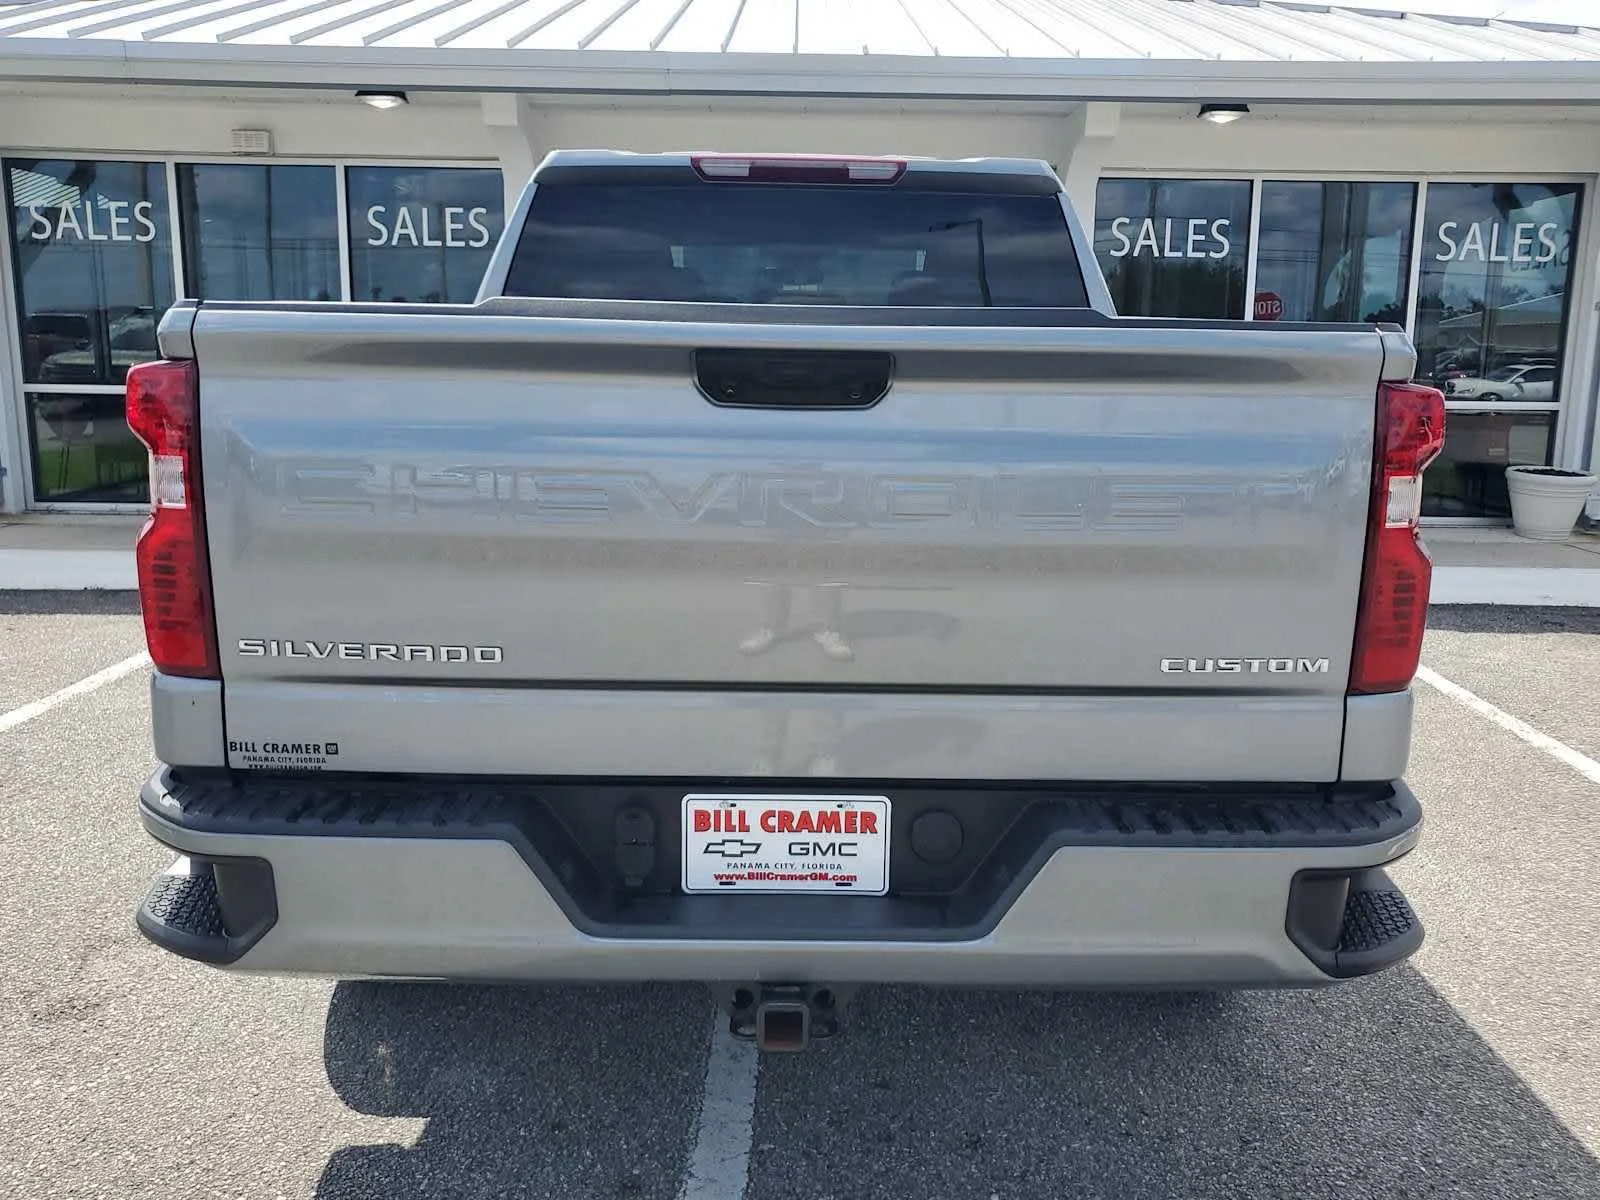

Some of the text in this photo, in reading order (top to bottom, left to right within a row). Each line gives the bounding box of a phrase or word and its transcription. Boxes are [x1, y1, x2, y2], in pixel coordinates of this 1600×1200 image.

[30, 200, 156, 243] SALES
[366, 205, 490, 249] SALES
[1109, 216, 1231, 260] SALES
[1435, 221, 1558, 263] SALES
[237, 638, 504, 664] SILVERADO
[1160, 657, 1330, 673] CUSTOM
[229, 741, 257, 752] BILL
[262, 742, 321, 754] CRAMER
[694, 809, 878, 834] BILL CRAMER
[788, 841, 858, 857] GMC
[713, 872, 858, 883] www.BillCramerGM.com
[727, 861, 842, 871] PANAMA CITY, FLORIDA
